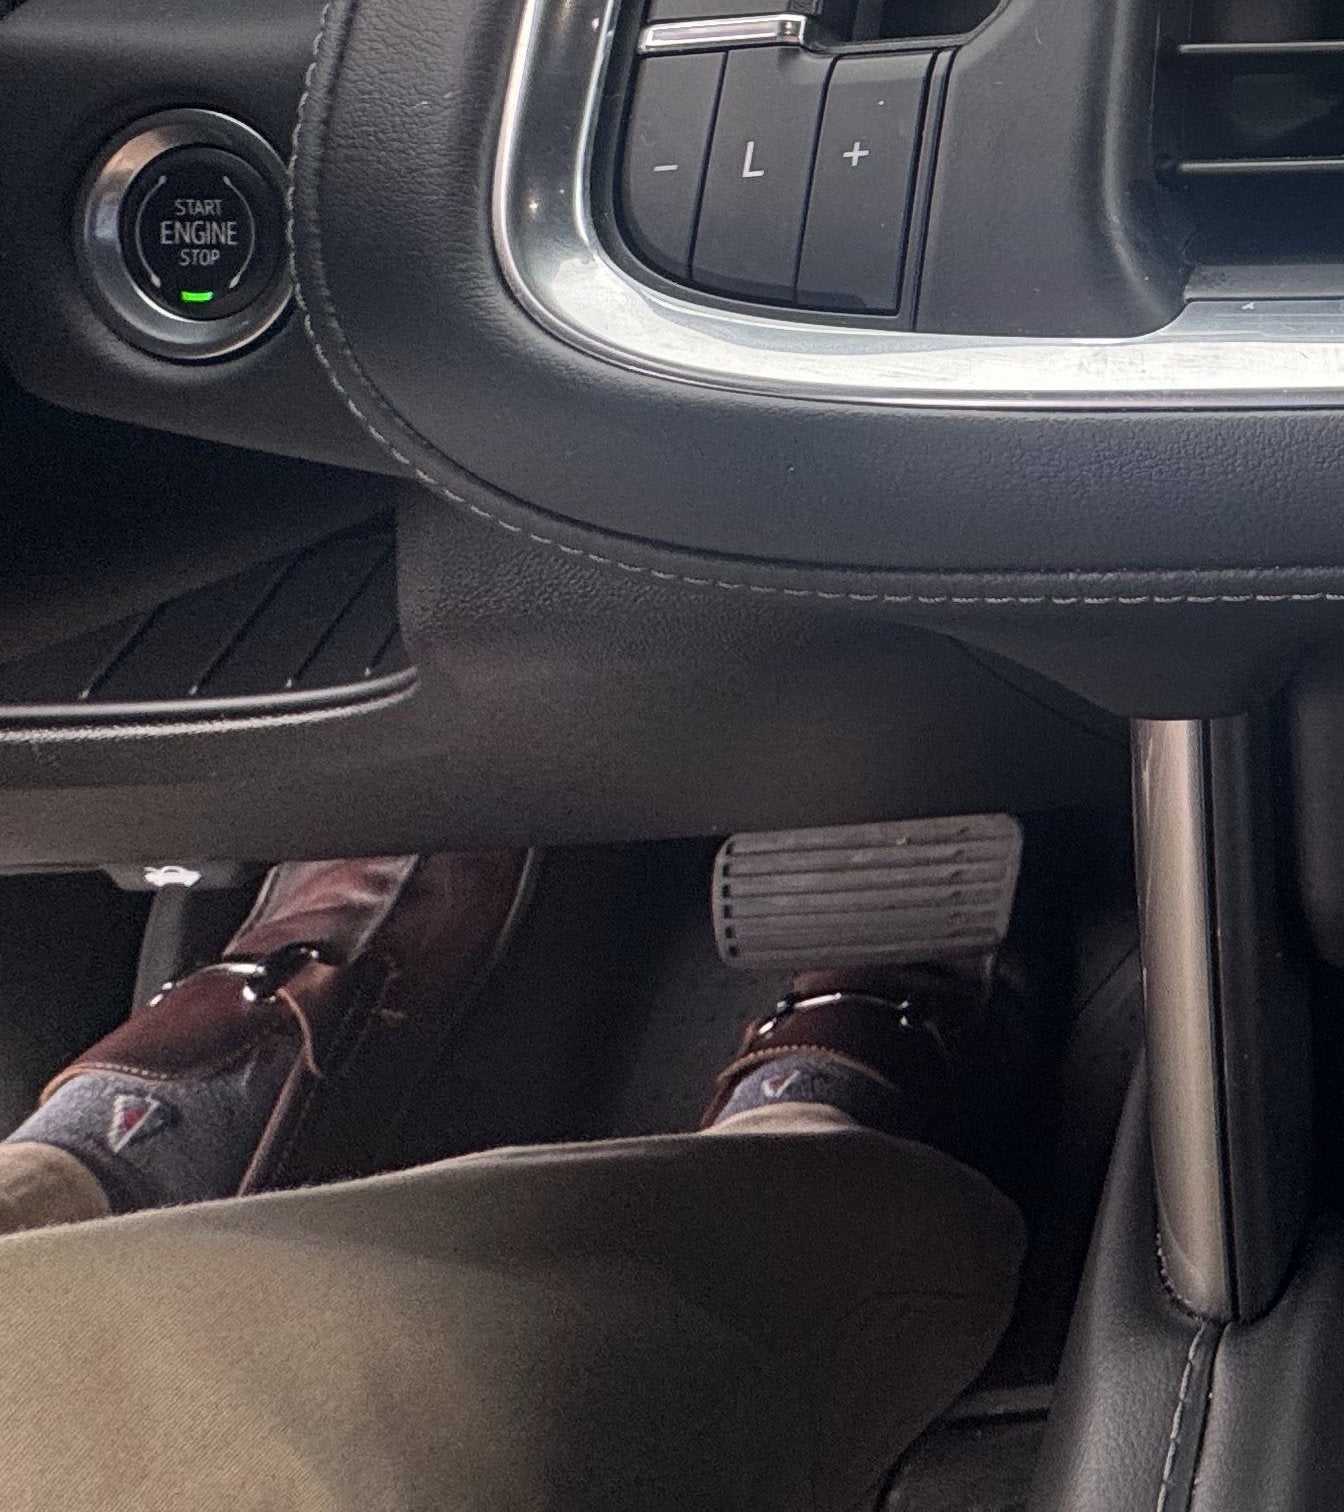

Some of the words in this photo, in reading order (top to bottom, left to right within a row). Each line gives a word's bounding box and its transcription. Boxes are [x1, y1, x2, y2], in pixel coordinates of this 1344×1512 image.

[741, 140, 764, 178] L
[174, 198, 222, 217] START
[160, 220, 238, 245] ENGINE
[179, 248, 220, 267] STOP
